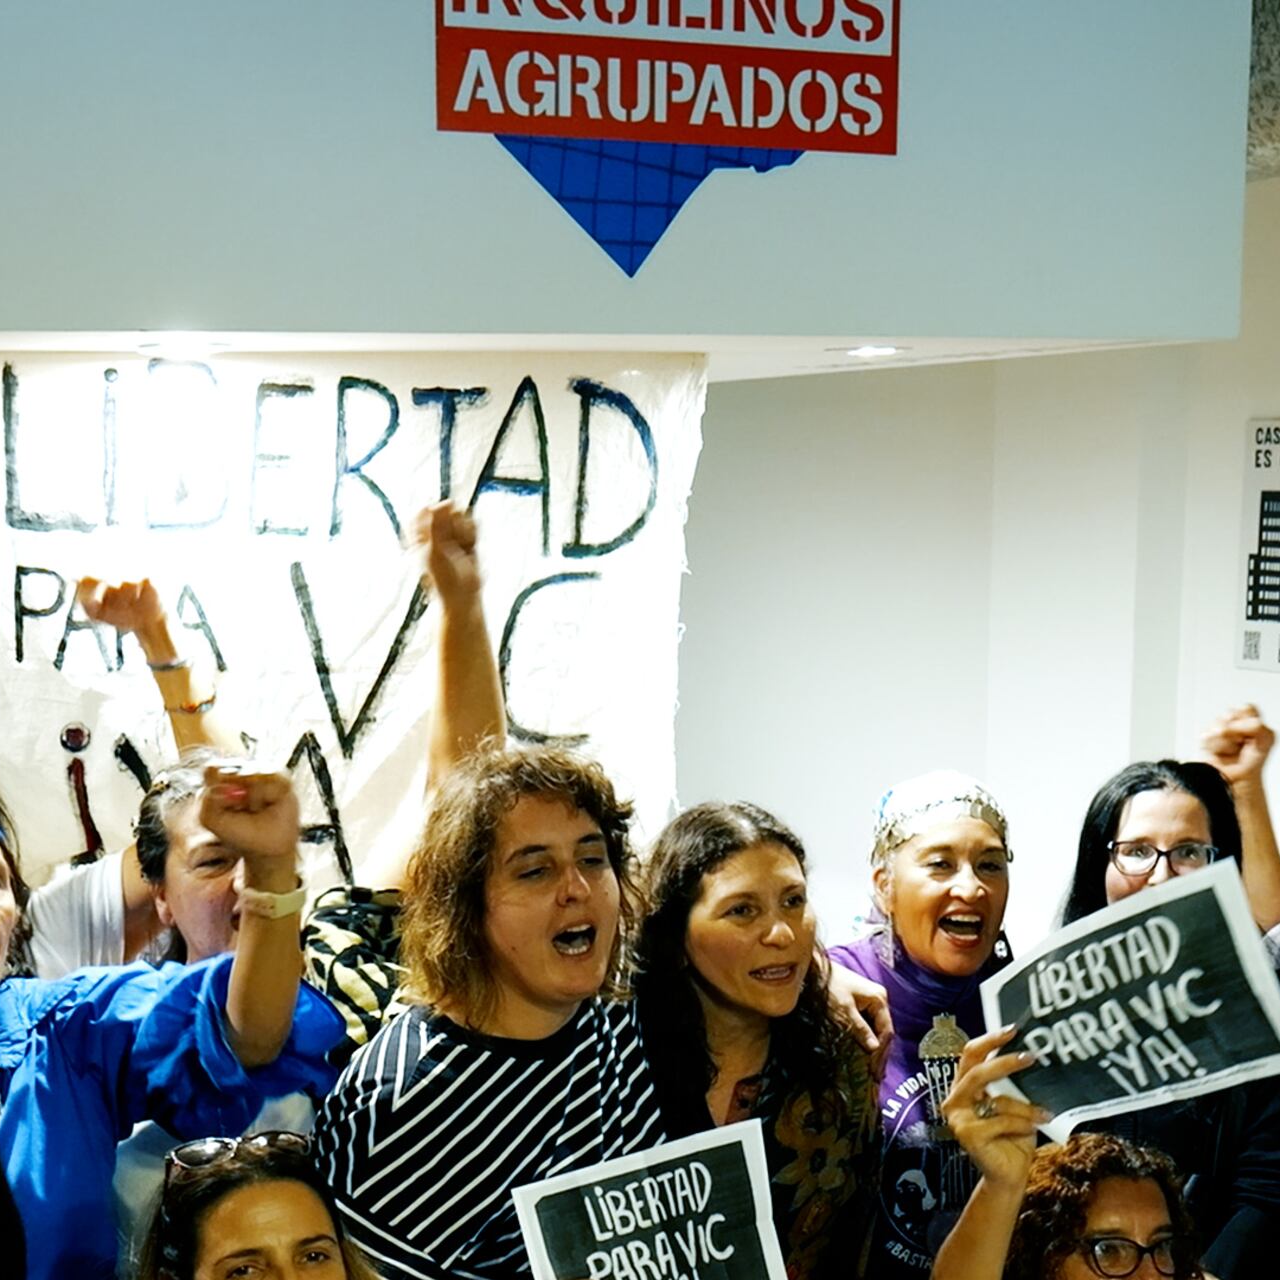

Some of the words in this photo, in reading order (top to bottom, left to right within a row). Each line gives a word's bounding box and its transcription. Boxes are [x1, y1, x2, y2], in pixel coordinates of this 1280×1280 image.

[453, 48, 884, 137] AGRUPADOS
[2, 358, 660, 560] LIBERTAD
[1255, 449, 1271, 469] ES
[288, 560, 604, 756] VC
[1027, 916, 1181, 1019] LIBERTAD
[1023, 1001, 1144, 1067] PARA
[1129, 968, 1223, 1029] VIC
[882, 1098, 903, 1120] LA
[895, 1072, 929, 1101] VIDA
[584, 1161, 713, 1243] LIBERTAD
[674, 1213, 735, 1269] VIC
